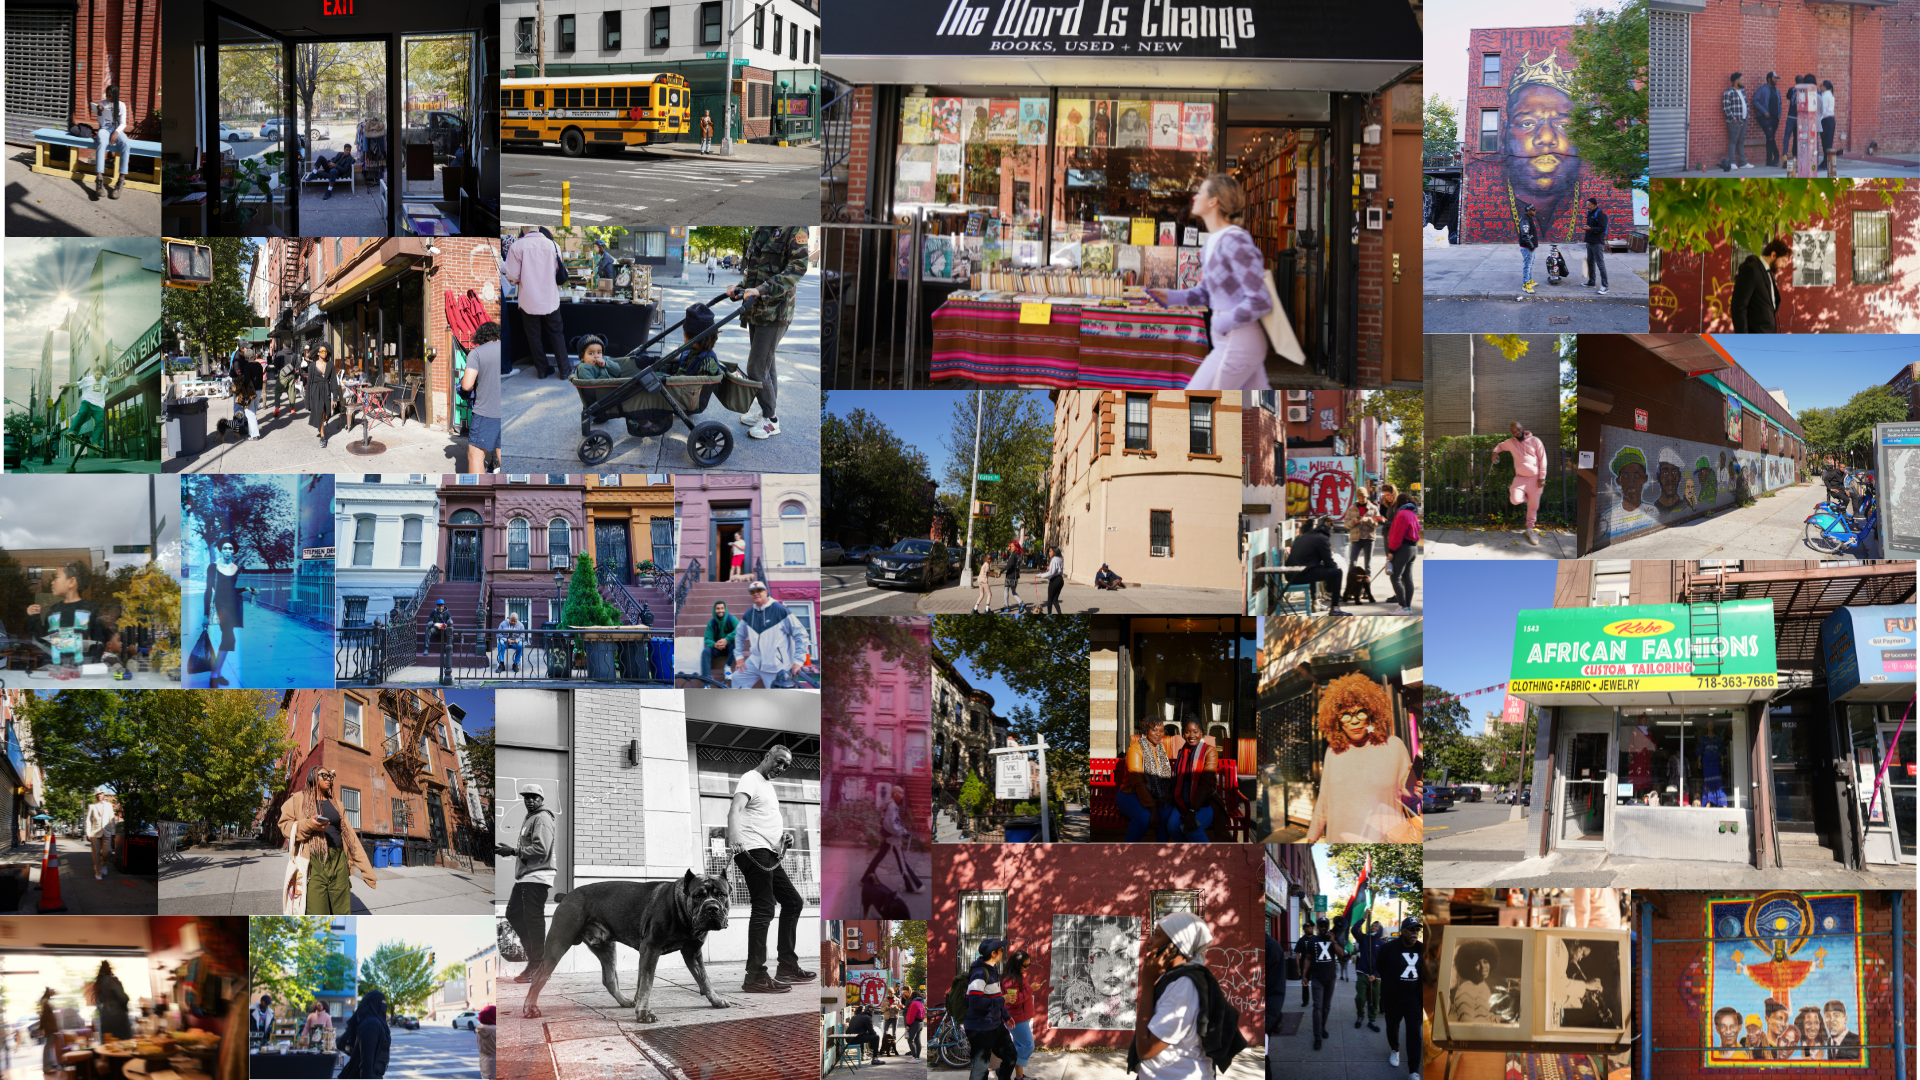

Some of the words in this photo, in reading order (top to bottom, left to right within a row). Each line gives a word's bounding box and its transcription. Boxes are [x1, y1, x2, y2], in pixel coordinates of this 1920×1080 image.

[323, 0, 354, 16] EXIT
[935, 0, 990, 36] The
[991, 0, 1085, 38] Word
[1093, 0, 1129, 36] Is
[1140, 0, 1257, 49] Change
[989, 40, 1057, 52] BOOKS,
[1064, 40, 1115, 51] USED
[1120, 42, 1132, 51] +
[1137, 40, 1184, 52] NEW
[1500, 29, 1559, 54] KING
[1309, 460, 1334, 473] WHAT
[1523, 625, 1540, 633] 1543
[1614, 619, 1664, 635] Kebe
[1526, 639, 1628, 664] AFRICAN
[1641, 634, 1760, 660] FASHIONS
[1882, 637, 1907, 645] Payment
[1584, 664, 1627, 676] CUSTOM
[1631, 661, 1693, 675] TAILORING
[1511, 680, 1553, 692] CLOTHING
[1559, 680, 1592, 692] FABRIC
[1598, 677, 1640, 691] JEWELRY
[1696, 673, 1776, 690] 718-363-7686
[1318, 941, 1332, 961] X
[1400, 952, 1419, 979] X
